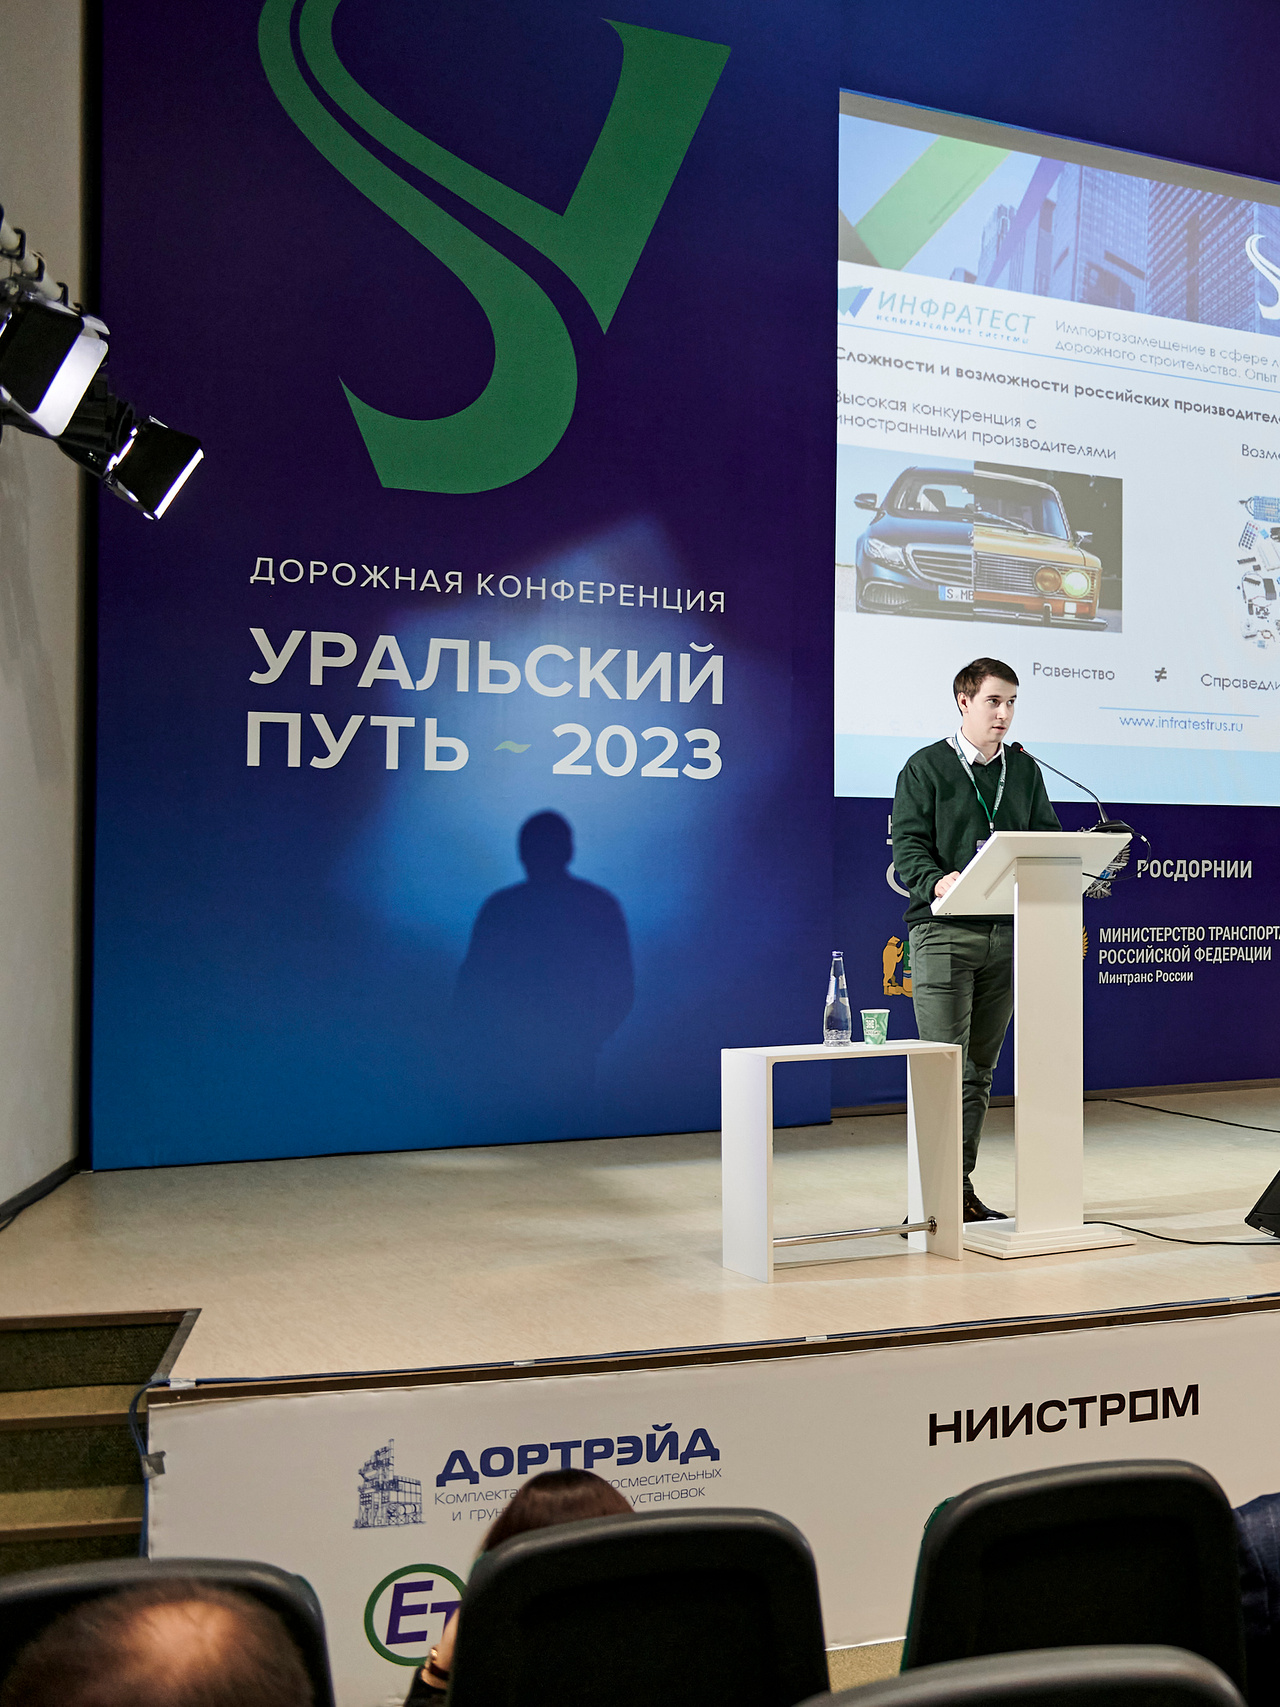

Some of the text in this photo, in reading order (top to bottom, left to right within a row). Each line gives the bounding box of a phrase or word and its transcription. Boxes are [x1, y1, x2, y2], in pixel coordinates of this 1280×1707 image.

[877, 291, 1035, 334] ИНФРАТЕСТ
[1055, 320, 1205, 356] Импортозамещение
[1210, 348, 1216, 357] в
[1220, 349, 1268, 367] сфере
[1055, 340, 1135, 361] дорожного
[1140, 353, 1241, 378] строительства.
[1245, 368, 1277, 384] Опыт
[941, 364, 950, 376] и
[956, 368, 1069, 394] возможности
[1075, 384, 1169, 408] российских
[912, 402, 1021, 428] конкуренция
[1026, 417, 1037, 430] с
[972, 429, 1117, 460] производителями
[250, 556, 726, 614] ДОРОЖНАЯ КОНФЕРЕНЦИЯ
[248, 627, 724, 705] УРАЛЬСКИЙ
[1032, 662, 1116, 683] Равенство
[1119, 716, 1244, 734] www.infratestrus.ru
[246, 711, 723, 780] ПУТЬ 2023
[1136, 858, 1252, 879] РОСДОРНИИ
[1099, 926, 1205, 944] МИНИСТЕРСТВО
[1099, 945, 1272, 965] РОССИЙСКОЙ ФЕДЕРАЦИИ
[1099, 969, 1194, 985] Минтранс России
[928, 1383, 1200, 1448] НИИСТРОМ
[435, 1423, 721, 1487] ДОРТРЭЙД
[452, 1512, 461, 1521] и
[630, 1487, 706, 1506] установок
